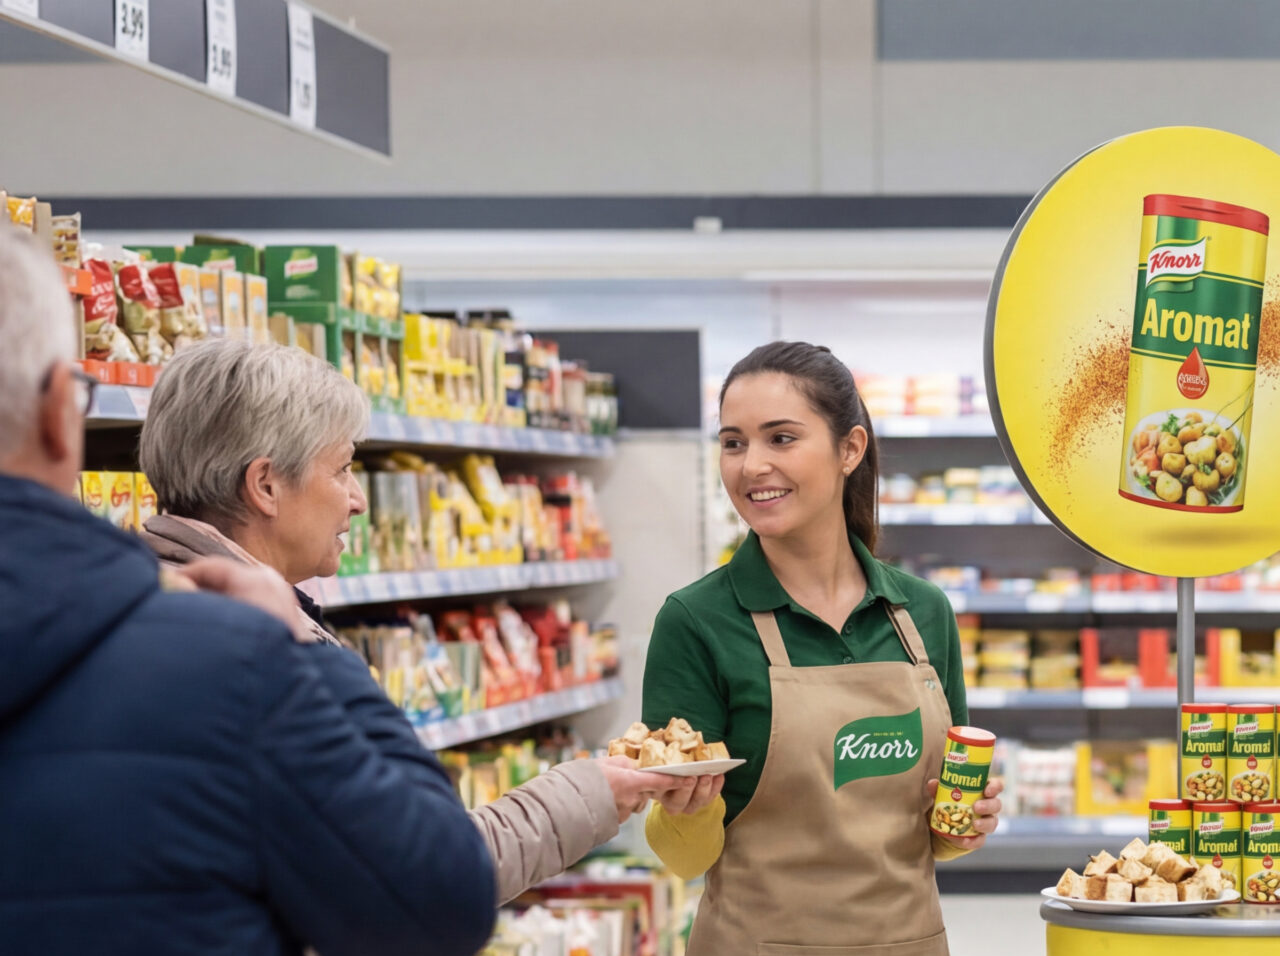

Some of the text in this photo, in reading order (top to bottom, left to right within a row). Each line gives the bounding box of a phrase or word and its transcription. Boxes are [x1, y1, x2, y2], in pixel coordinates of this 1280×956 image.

[1150, 250, 1203, 273] Knorr
[1141, 298, 1251, 350] Aromat
[836, 733, 919, 761] Knorr
